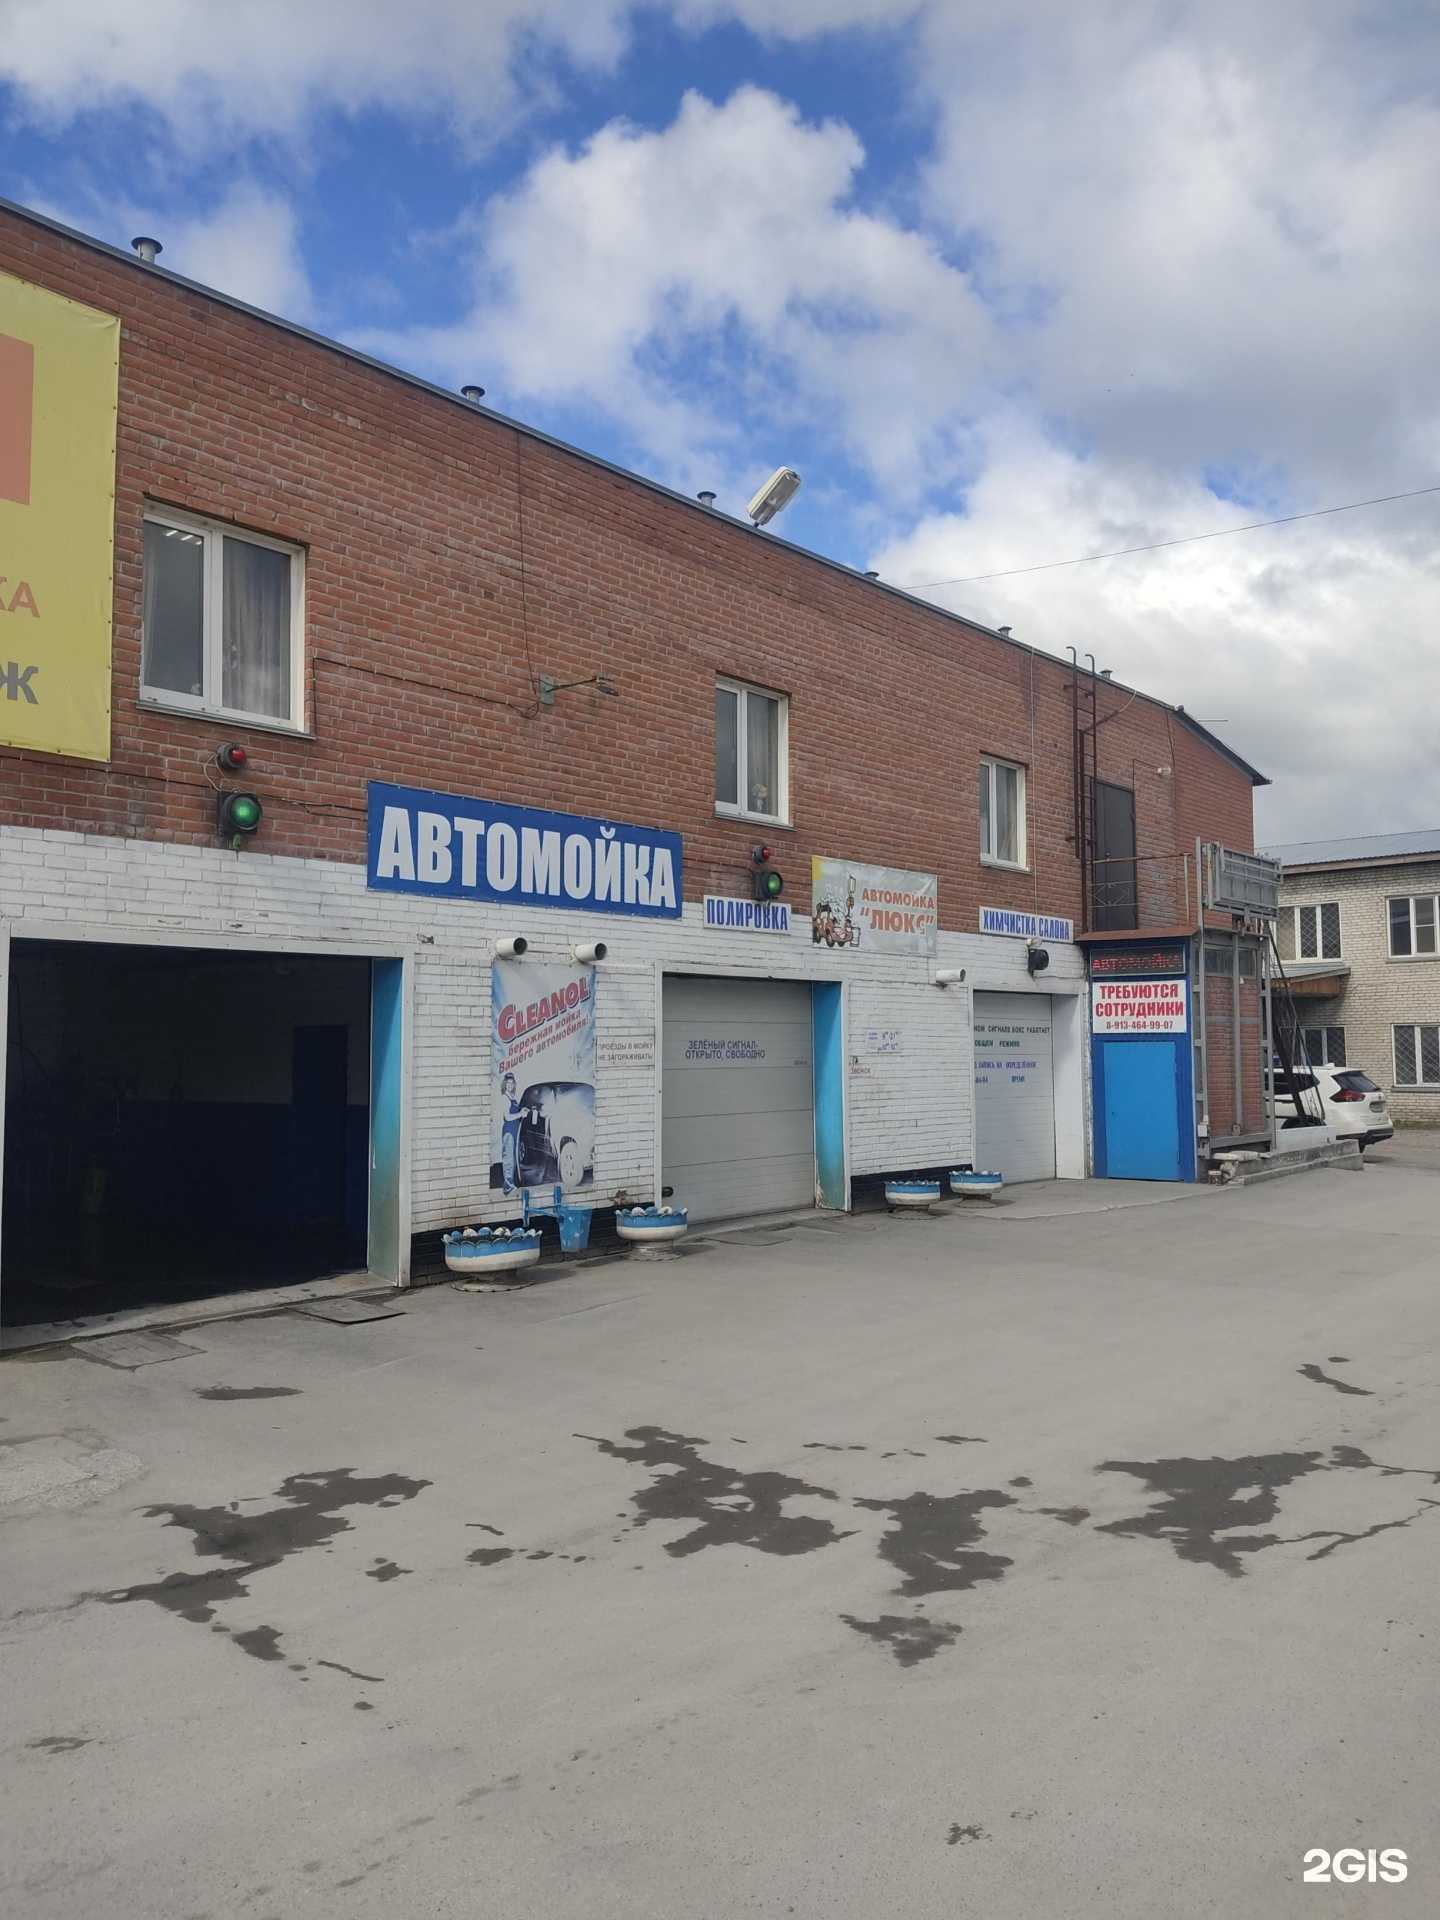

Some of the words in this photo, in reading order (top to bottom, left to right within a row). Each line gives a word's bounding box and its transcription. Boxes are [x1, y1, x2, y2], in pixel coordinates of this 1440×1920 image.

[376, 806, 677, 909] АВТОМОЙКА
[862, 888, 935, 909] АВТОМОЙКА
[706, 898, 788, 930] ПОЛИРОВКА
[983, 909, 1037, 936] ХИМЧИСТКА
[1039, 917, 1070, 940] САЛОНА
[1100, 983, 1179, 999] ТРЕБУЮТСЯ
[497, 976, 592, 1044] CLEANOL
[1095, 1000, 1184, 1018] СОТРУДНИКИ
[499, 1048, 534, 1074] Вашего
[725, 1049, 766, 1059] СВОБОДНО
